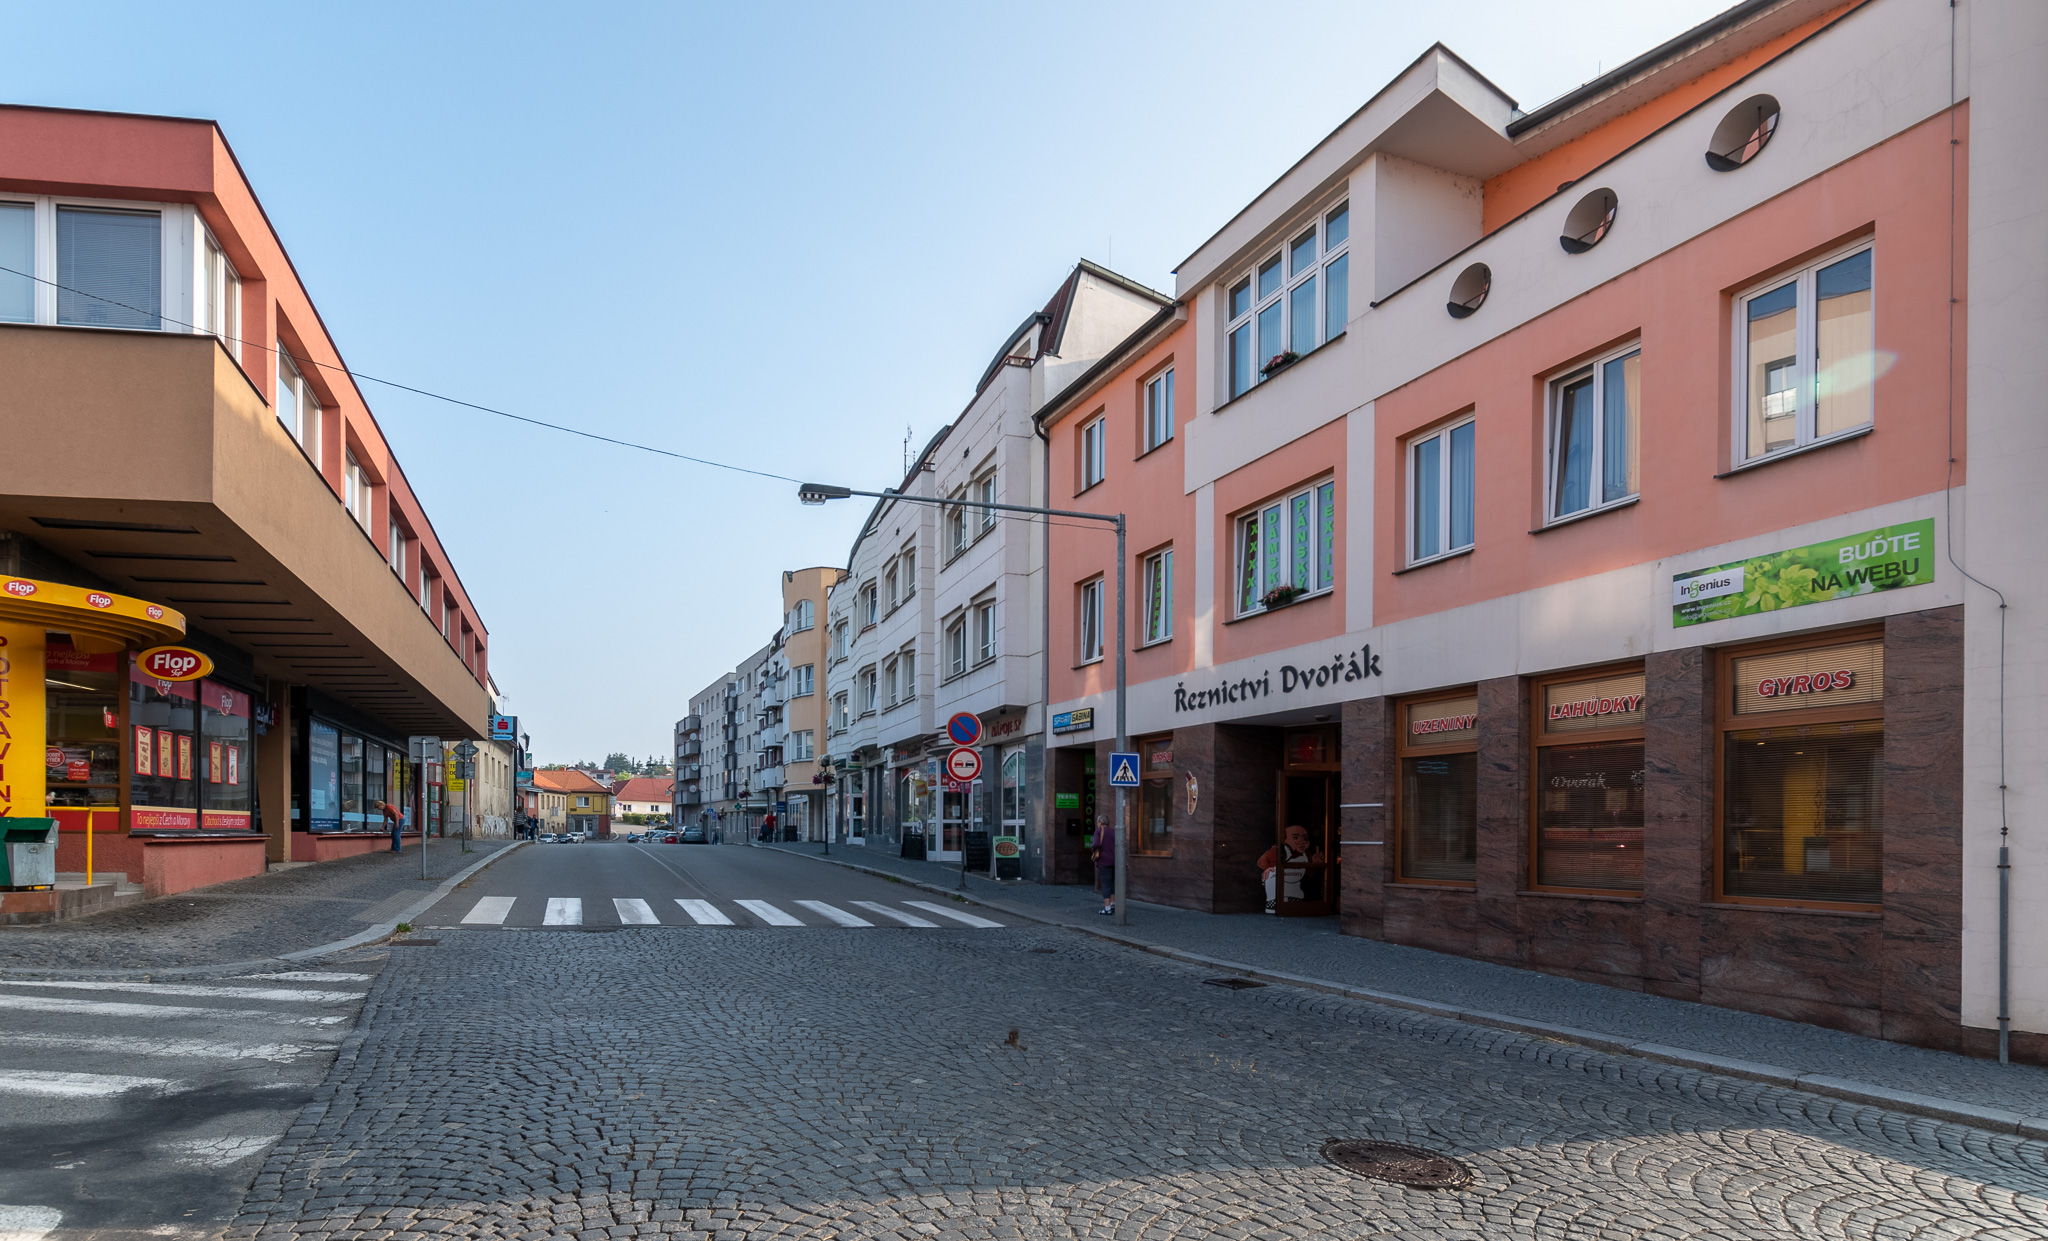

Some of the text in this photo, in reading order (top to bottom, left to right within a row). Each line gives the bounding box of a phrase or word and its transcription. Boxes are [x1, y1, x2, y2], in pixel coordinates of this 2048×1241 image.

[1324, 488, 1334, 582] TEXTIL
[1838, 531, 1921, 564] BUĎTE
[1246, 523, 1258, 606] XXXXL
[1268, 512, 1279, 590] DÁMSK
[8, 582, 34, 593] Flop
[1811, 557, 1920, 593] NA WEBU
[89, 594, 111, 606] Flop
[147, 606, 162, 617] Flop
[153, 653, 196, 672] Flop
[1279, 643, 1383, 694] Dvořák
[1756, 669, 1852, 697] GYROS
[1549, 694, 1642, 721] LAHŮDKY
[1412, 713, 1476, 735] UZENINY
